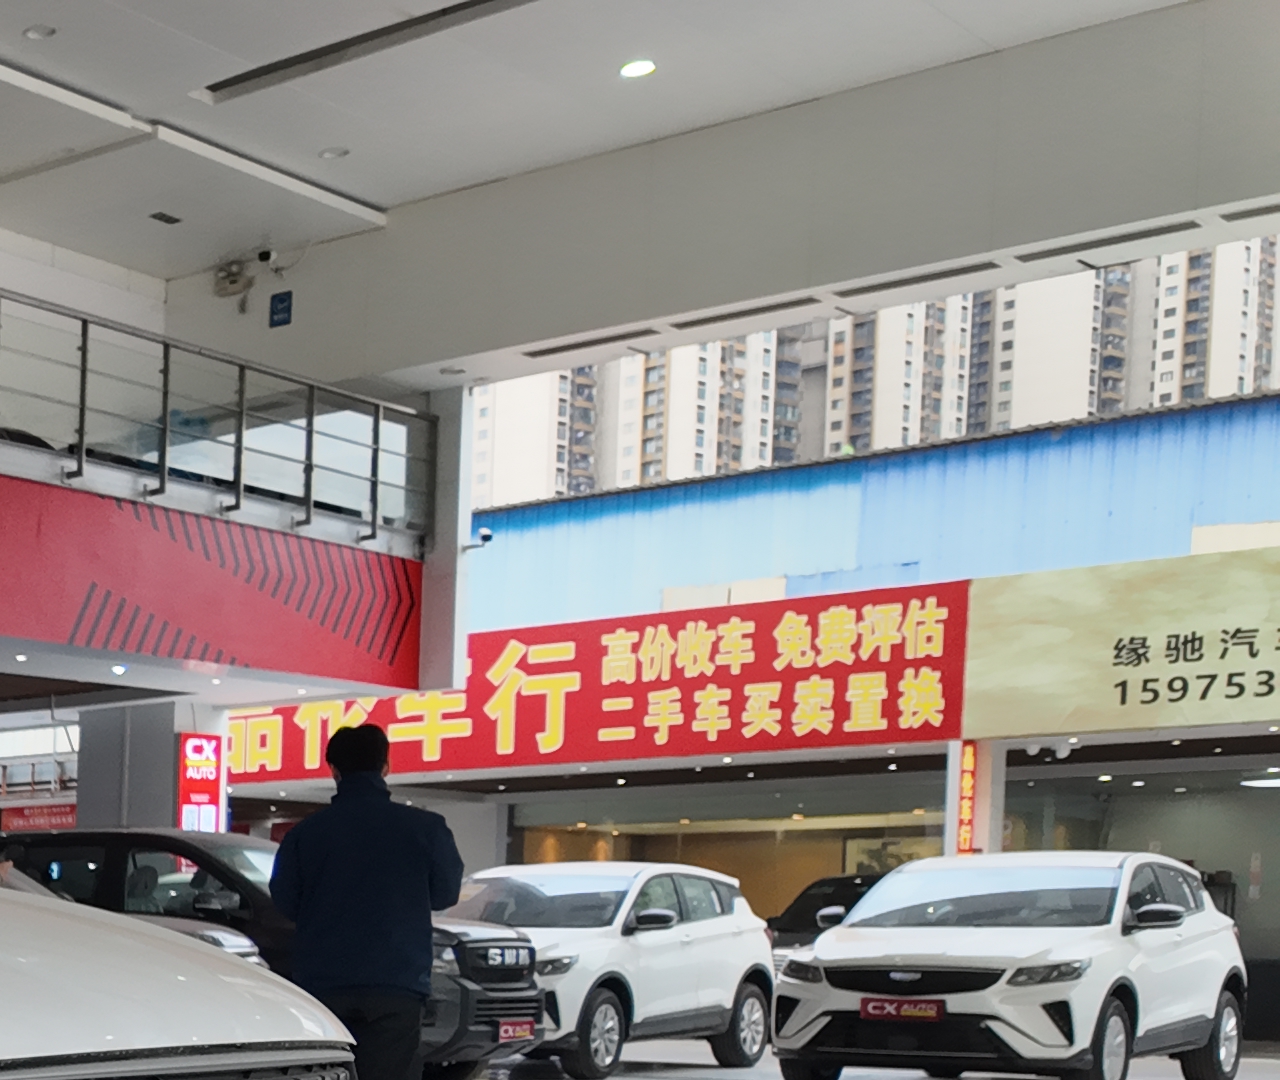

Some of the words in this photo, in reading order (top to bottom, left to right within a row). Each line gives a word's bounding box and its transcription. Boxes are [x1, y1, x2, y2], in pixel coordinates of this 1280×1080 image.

[600, 616, 756, 686] 高价收车
[772, 596, 949, 672] 免费评估
[1112, 627, 1280, 667] 缘驰汽
[597, 666, 946, 746] 二手车买卖置换
[1114, 670, 1276, 706] 159753
[185, 737, 217, 761] CX
[186, 766, 217, 780] AUTO
[867, 1002, 897, 1015] CX
